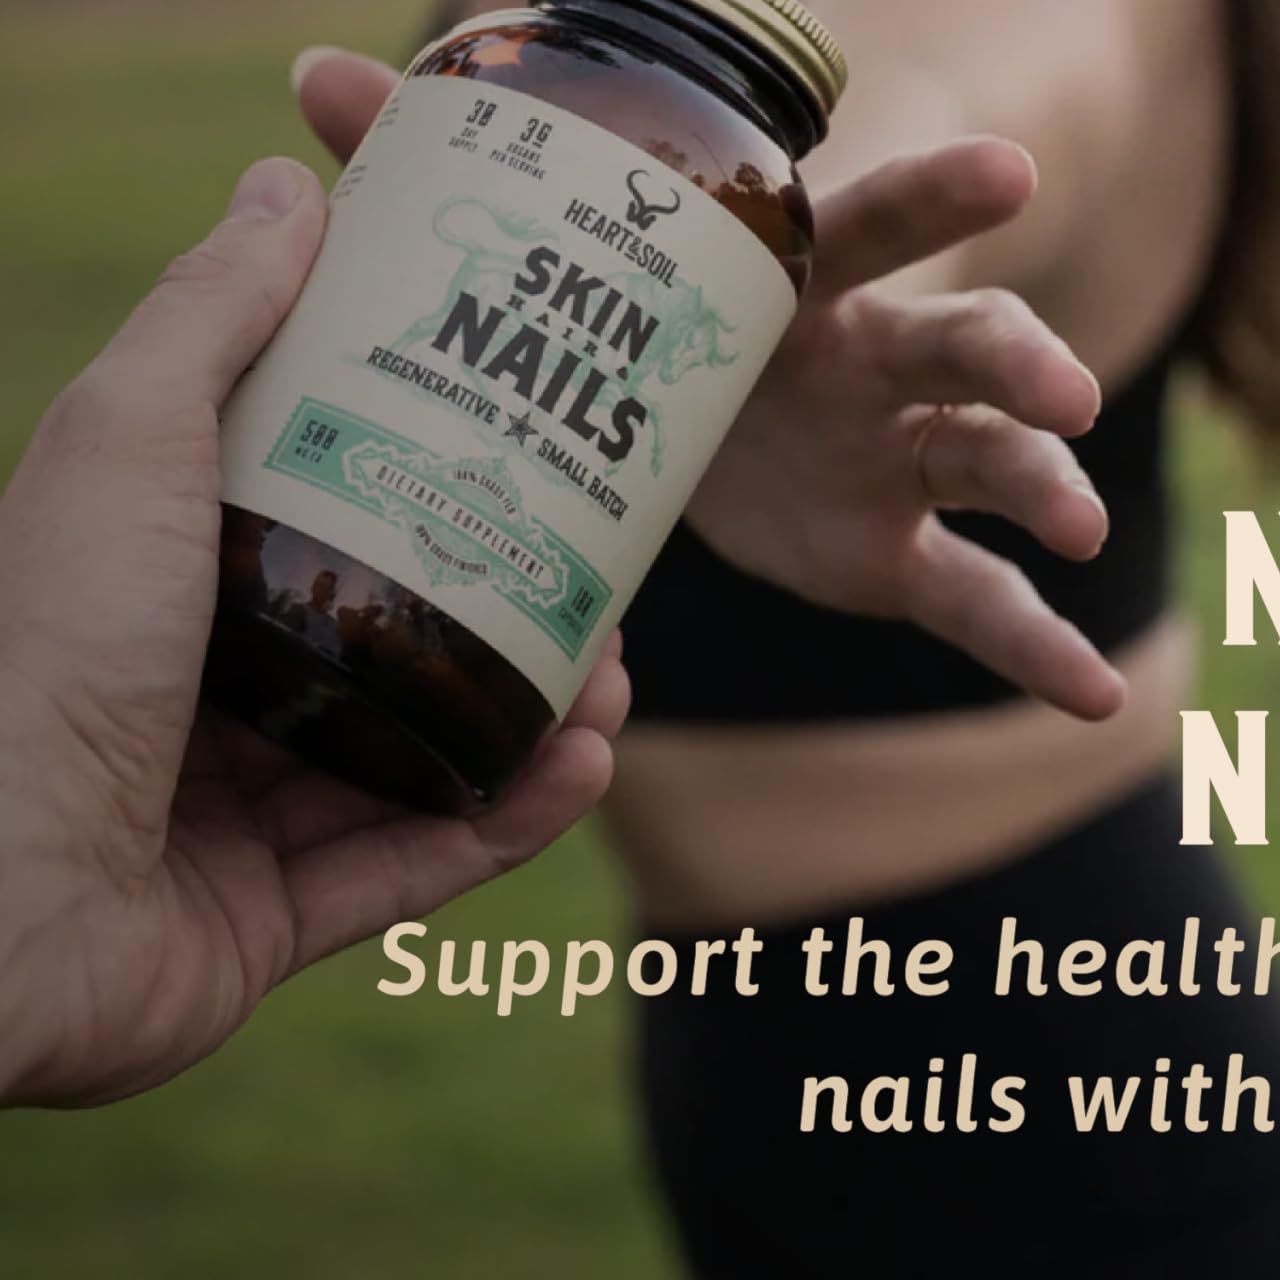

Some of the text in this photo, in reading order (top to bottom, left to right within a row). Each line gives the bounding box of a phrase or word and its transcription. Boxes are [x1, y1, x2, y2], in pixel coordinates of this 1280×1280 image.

[466, 99, 497, 127] 30
[506, 293, 598, 357] HAIR
[514, 246, 660, 364] SKIN
[430, 290, 647, 462] NAILS
[367, 346, 628, 523] REGENERATIVE SMALL BATCH
[376, 465, 544, 579] DIETARY SUPPLEMENT
